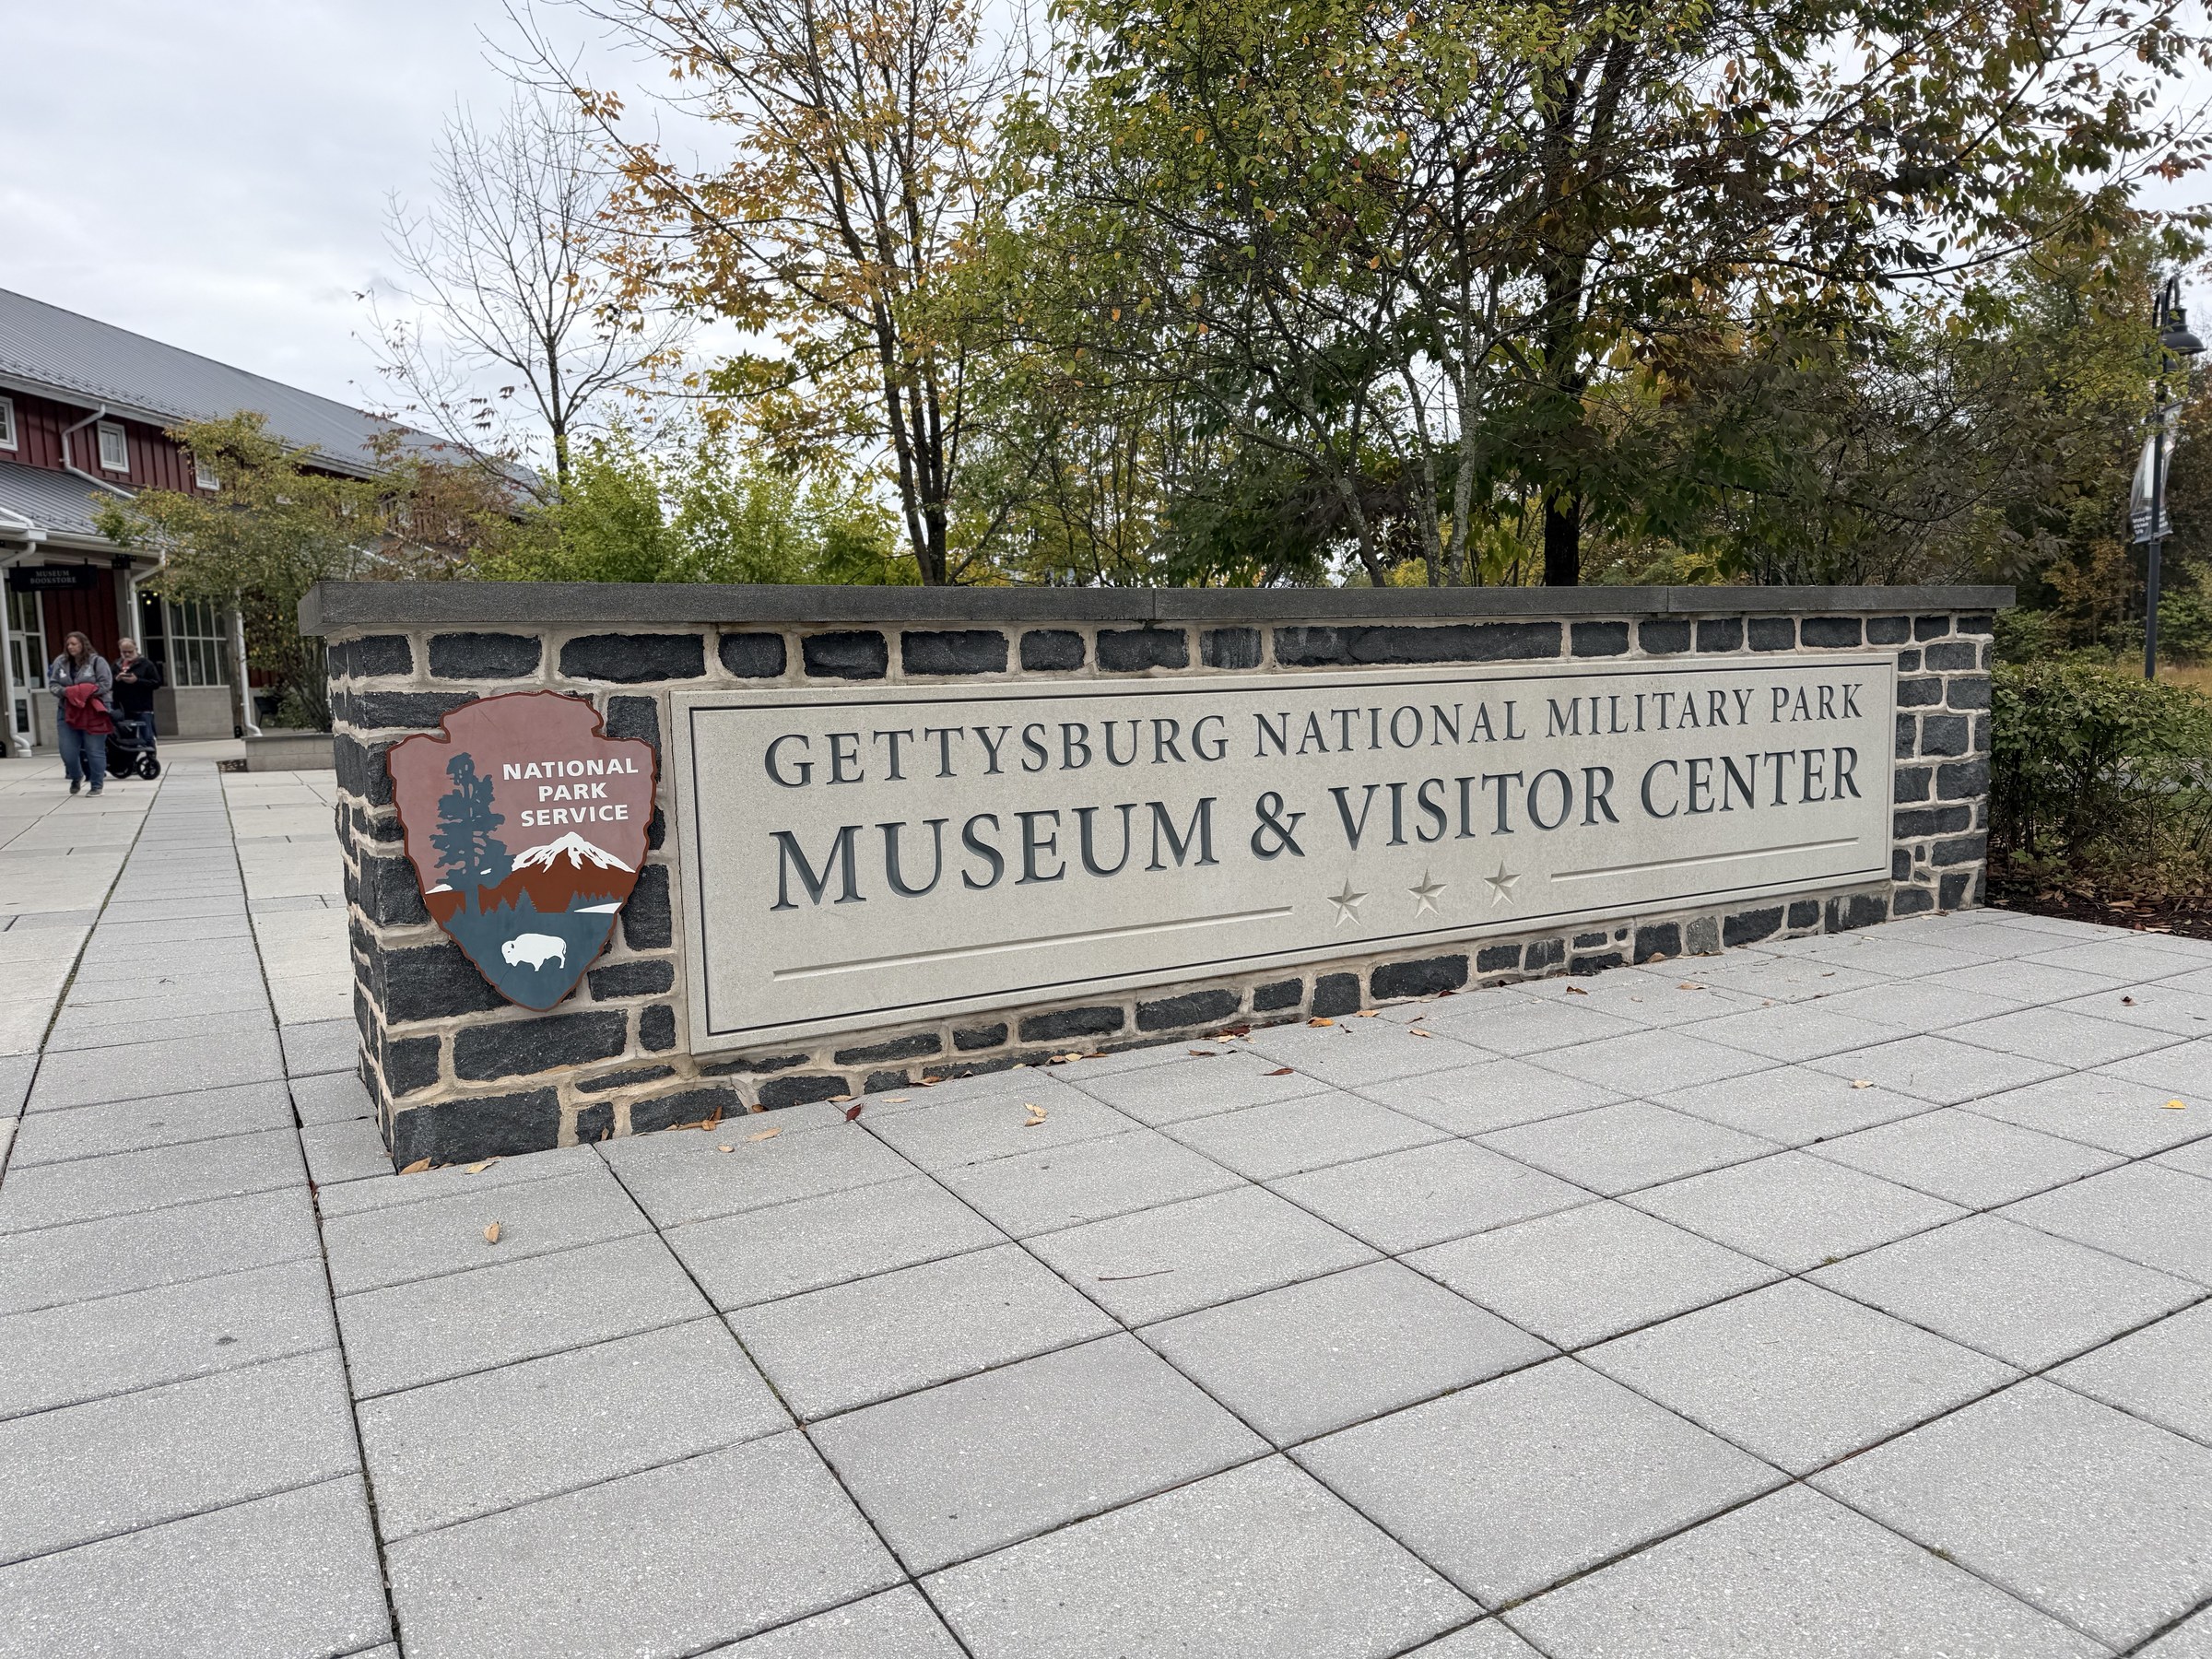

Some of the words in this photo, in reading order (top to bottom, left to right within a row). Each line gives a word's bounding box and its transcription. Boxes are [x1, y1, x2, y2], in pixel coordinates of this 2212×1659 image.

[763, 716, 1229, 788] GETTYSBURG
[1253, 700, 1526, 758] NATIONAL
[1546, 688, 1756, 738] MILITARY
[1771, 683, 1865, 724] PARK
[502, 757, 639, 781] NATIONAL
[537, 782, 608, 803] PARK
[520, 803, 629, 828] SERVICE
[769, 797, 1220, 912] MUSEUM
[1250, 790, 1307, 862] &
[1328, 764, 1620, 852] VISITOR
[1641, 746, 1863, 820] CENTER
